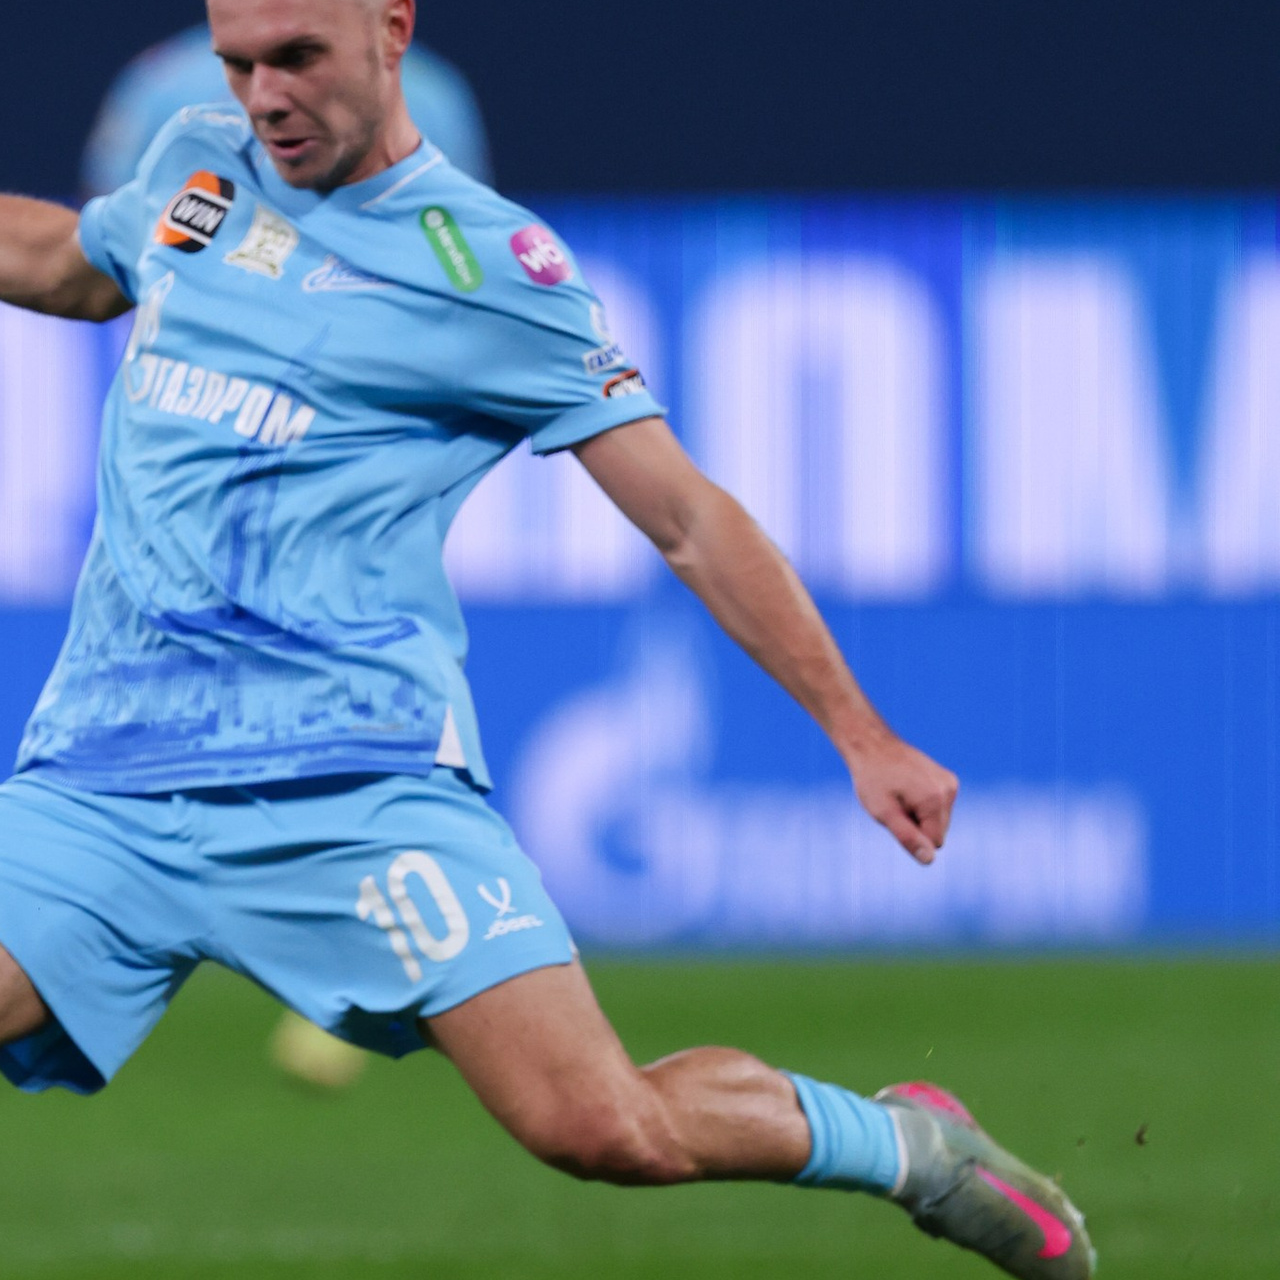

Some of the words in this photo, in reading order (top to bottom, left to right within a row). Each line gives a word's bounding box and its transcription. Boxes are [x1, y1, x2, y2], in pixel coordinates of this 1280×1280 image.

[172, 196, 225, 233] WIN
[148, 357, 317, 446] ГАЗПРОМ
[355, 850, 469, 985] 10
